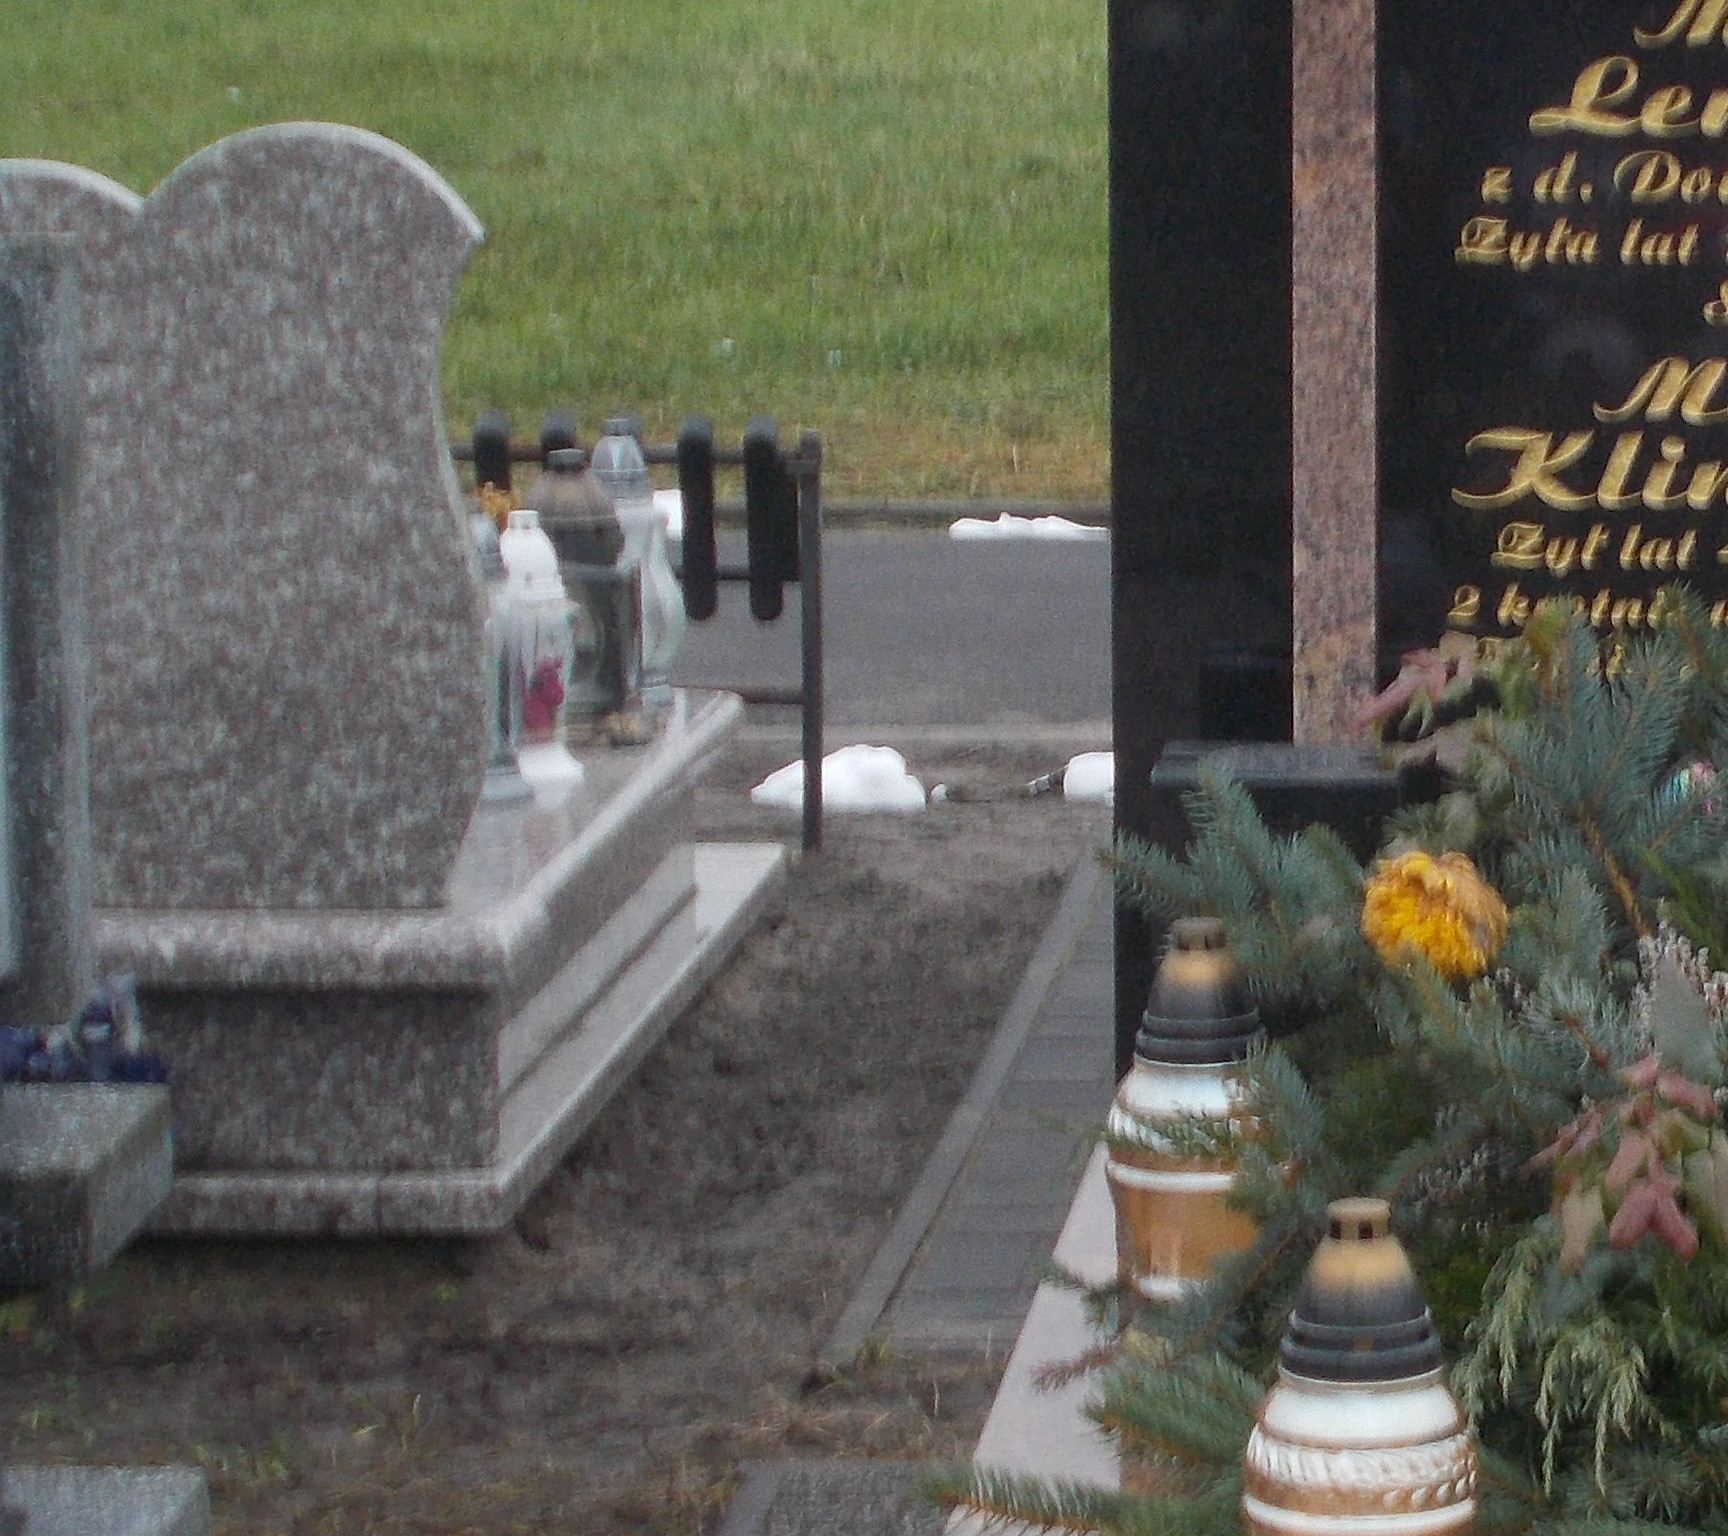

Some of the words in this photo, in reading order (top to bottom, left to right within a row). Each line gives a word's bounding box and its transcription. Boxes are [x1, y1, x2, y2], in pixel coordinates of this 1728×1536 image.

[1481, 166, 1512, 204] z
[1533, 150, 1593, 204] d.
[1620, 216, 1700, 266] lat
[1619, 523, 1699, 571] lat
[1447, 584, 1482, 628] 2
